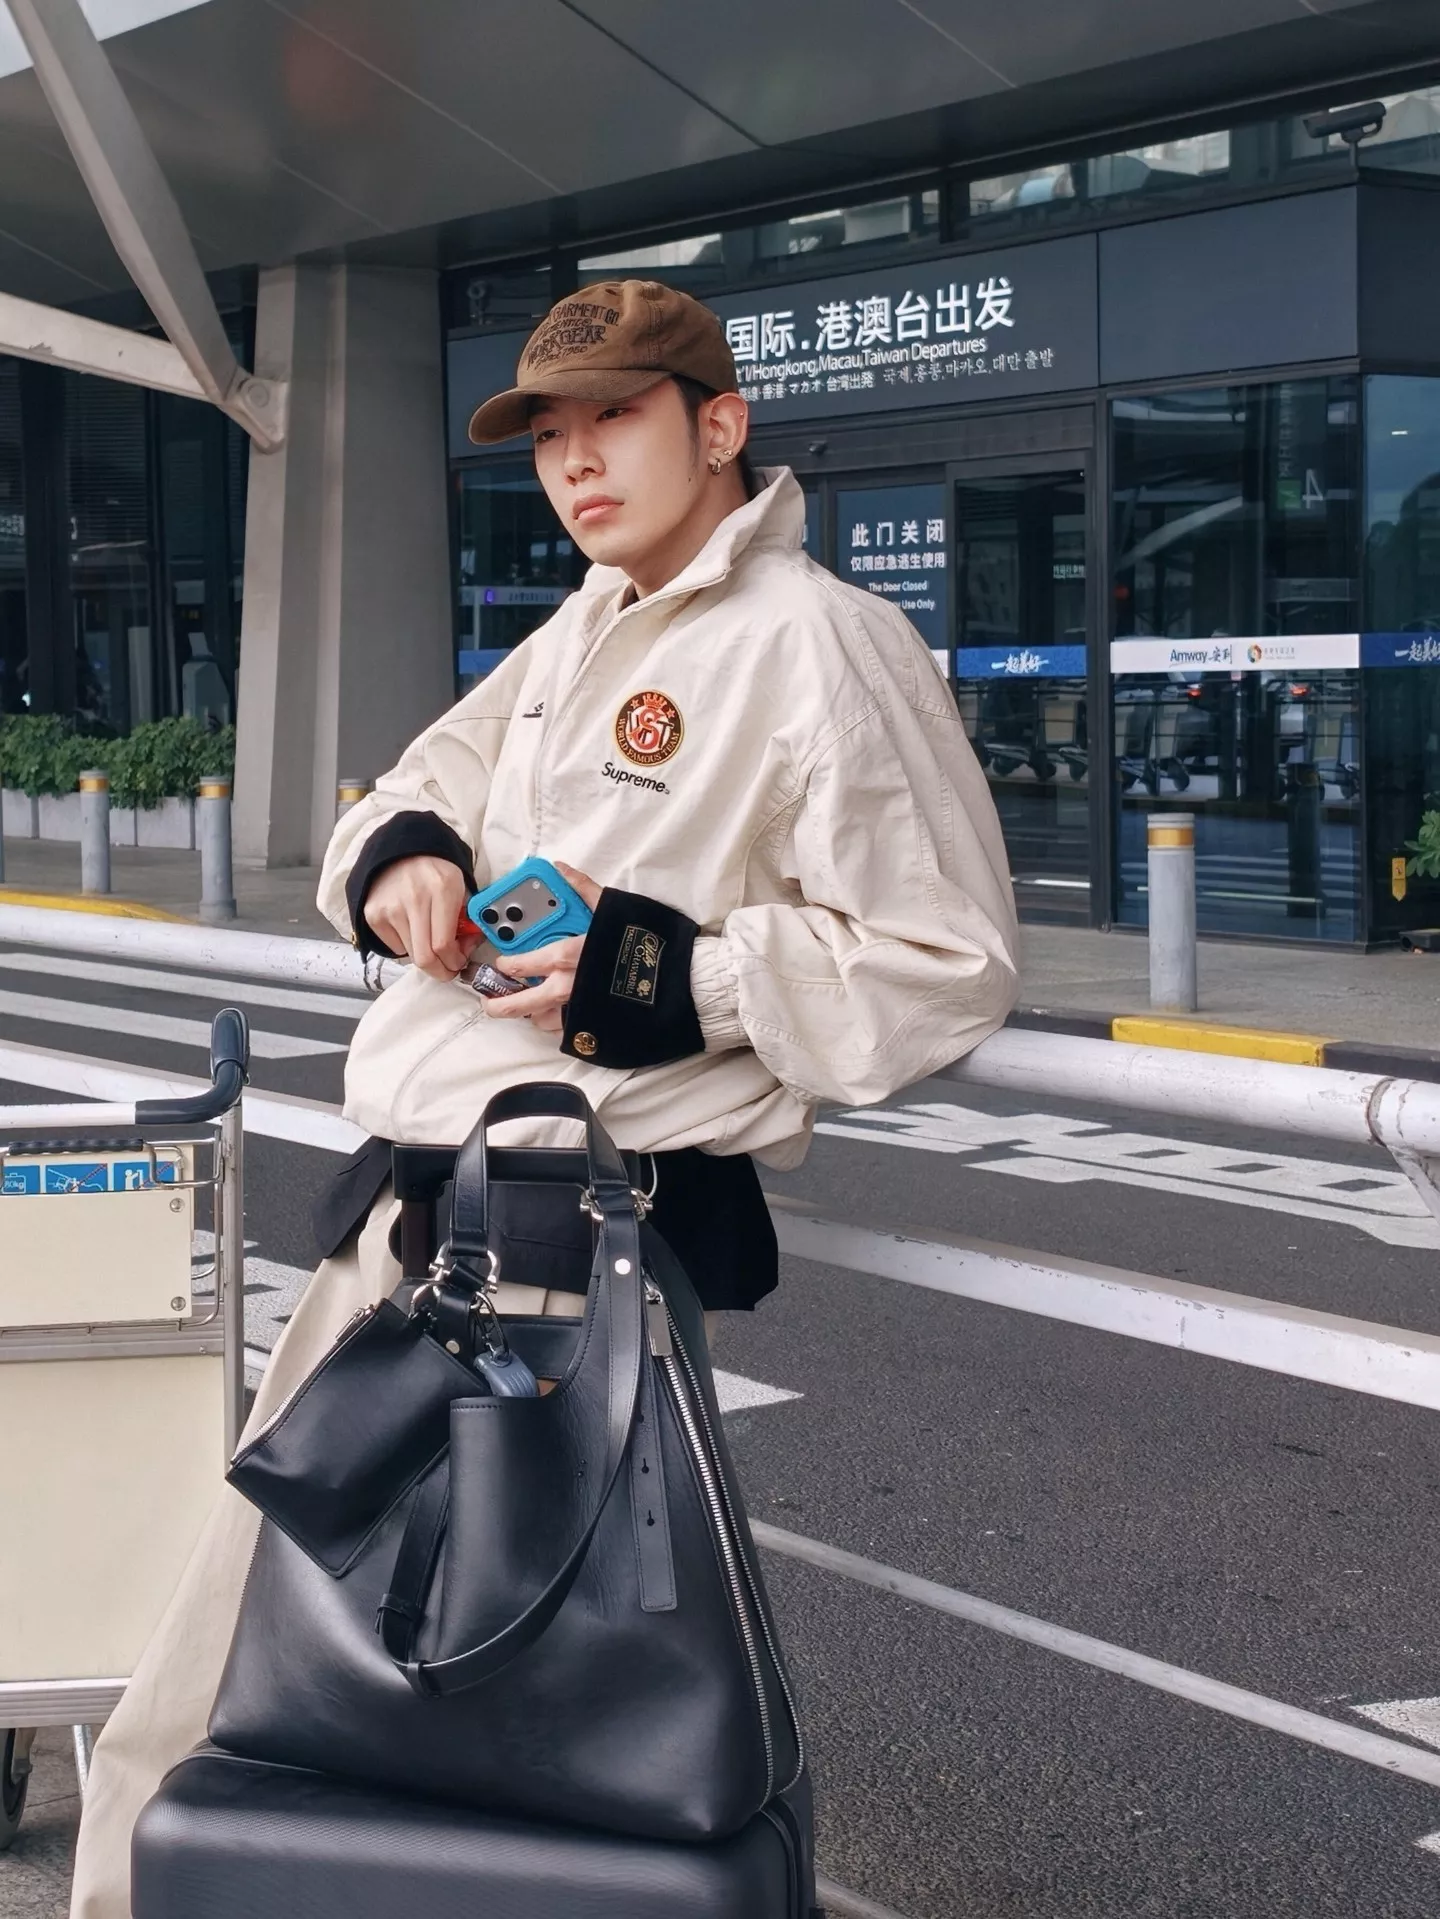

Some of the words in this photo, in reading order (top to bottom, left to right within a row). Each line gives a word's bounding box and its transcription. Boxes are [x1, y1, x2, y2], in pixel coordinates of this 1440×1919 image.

[911, 337, 988, 362] Departures
[851, 518, 945, 548] 此门关闭
[868, 582, 882, 592] The
[883, 582, 901, 592] Door
[902, 580, 928, 592] Closed
[901, 600, 916, 610] Use
[917, 598, 936, 611] Only
[1170, 648, 1208, 664] Amway
[616, 717, 630, 752] WORLD
[627, 749, 662, 764] FAMOUS
[661, 731, 680, 756] TEAM
[601, 761, 667, 793] Supreme
